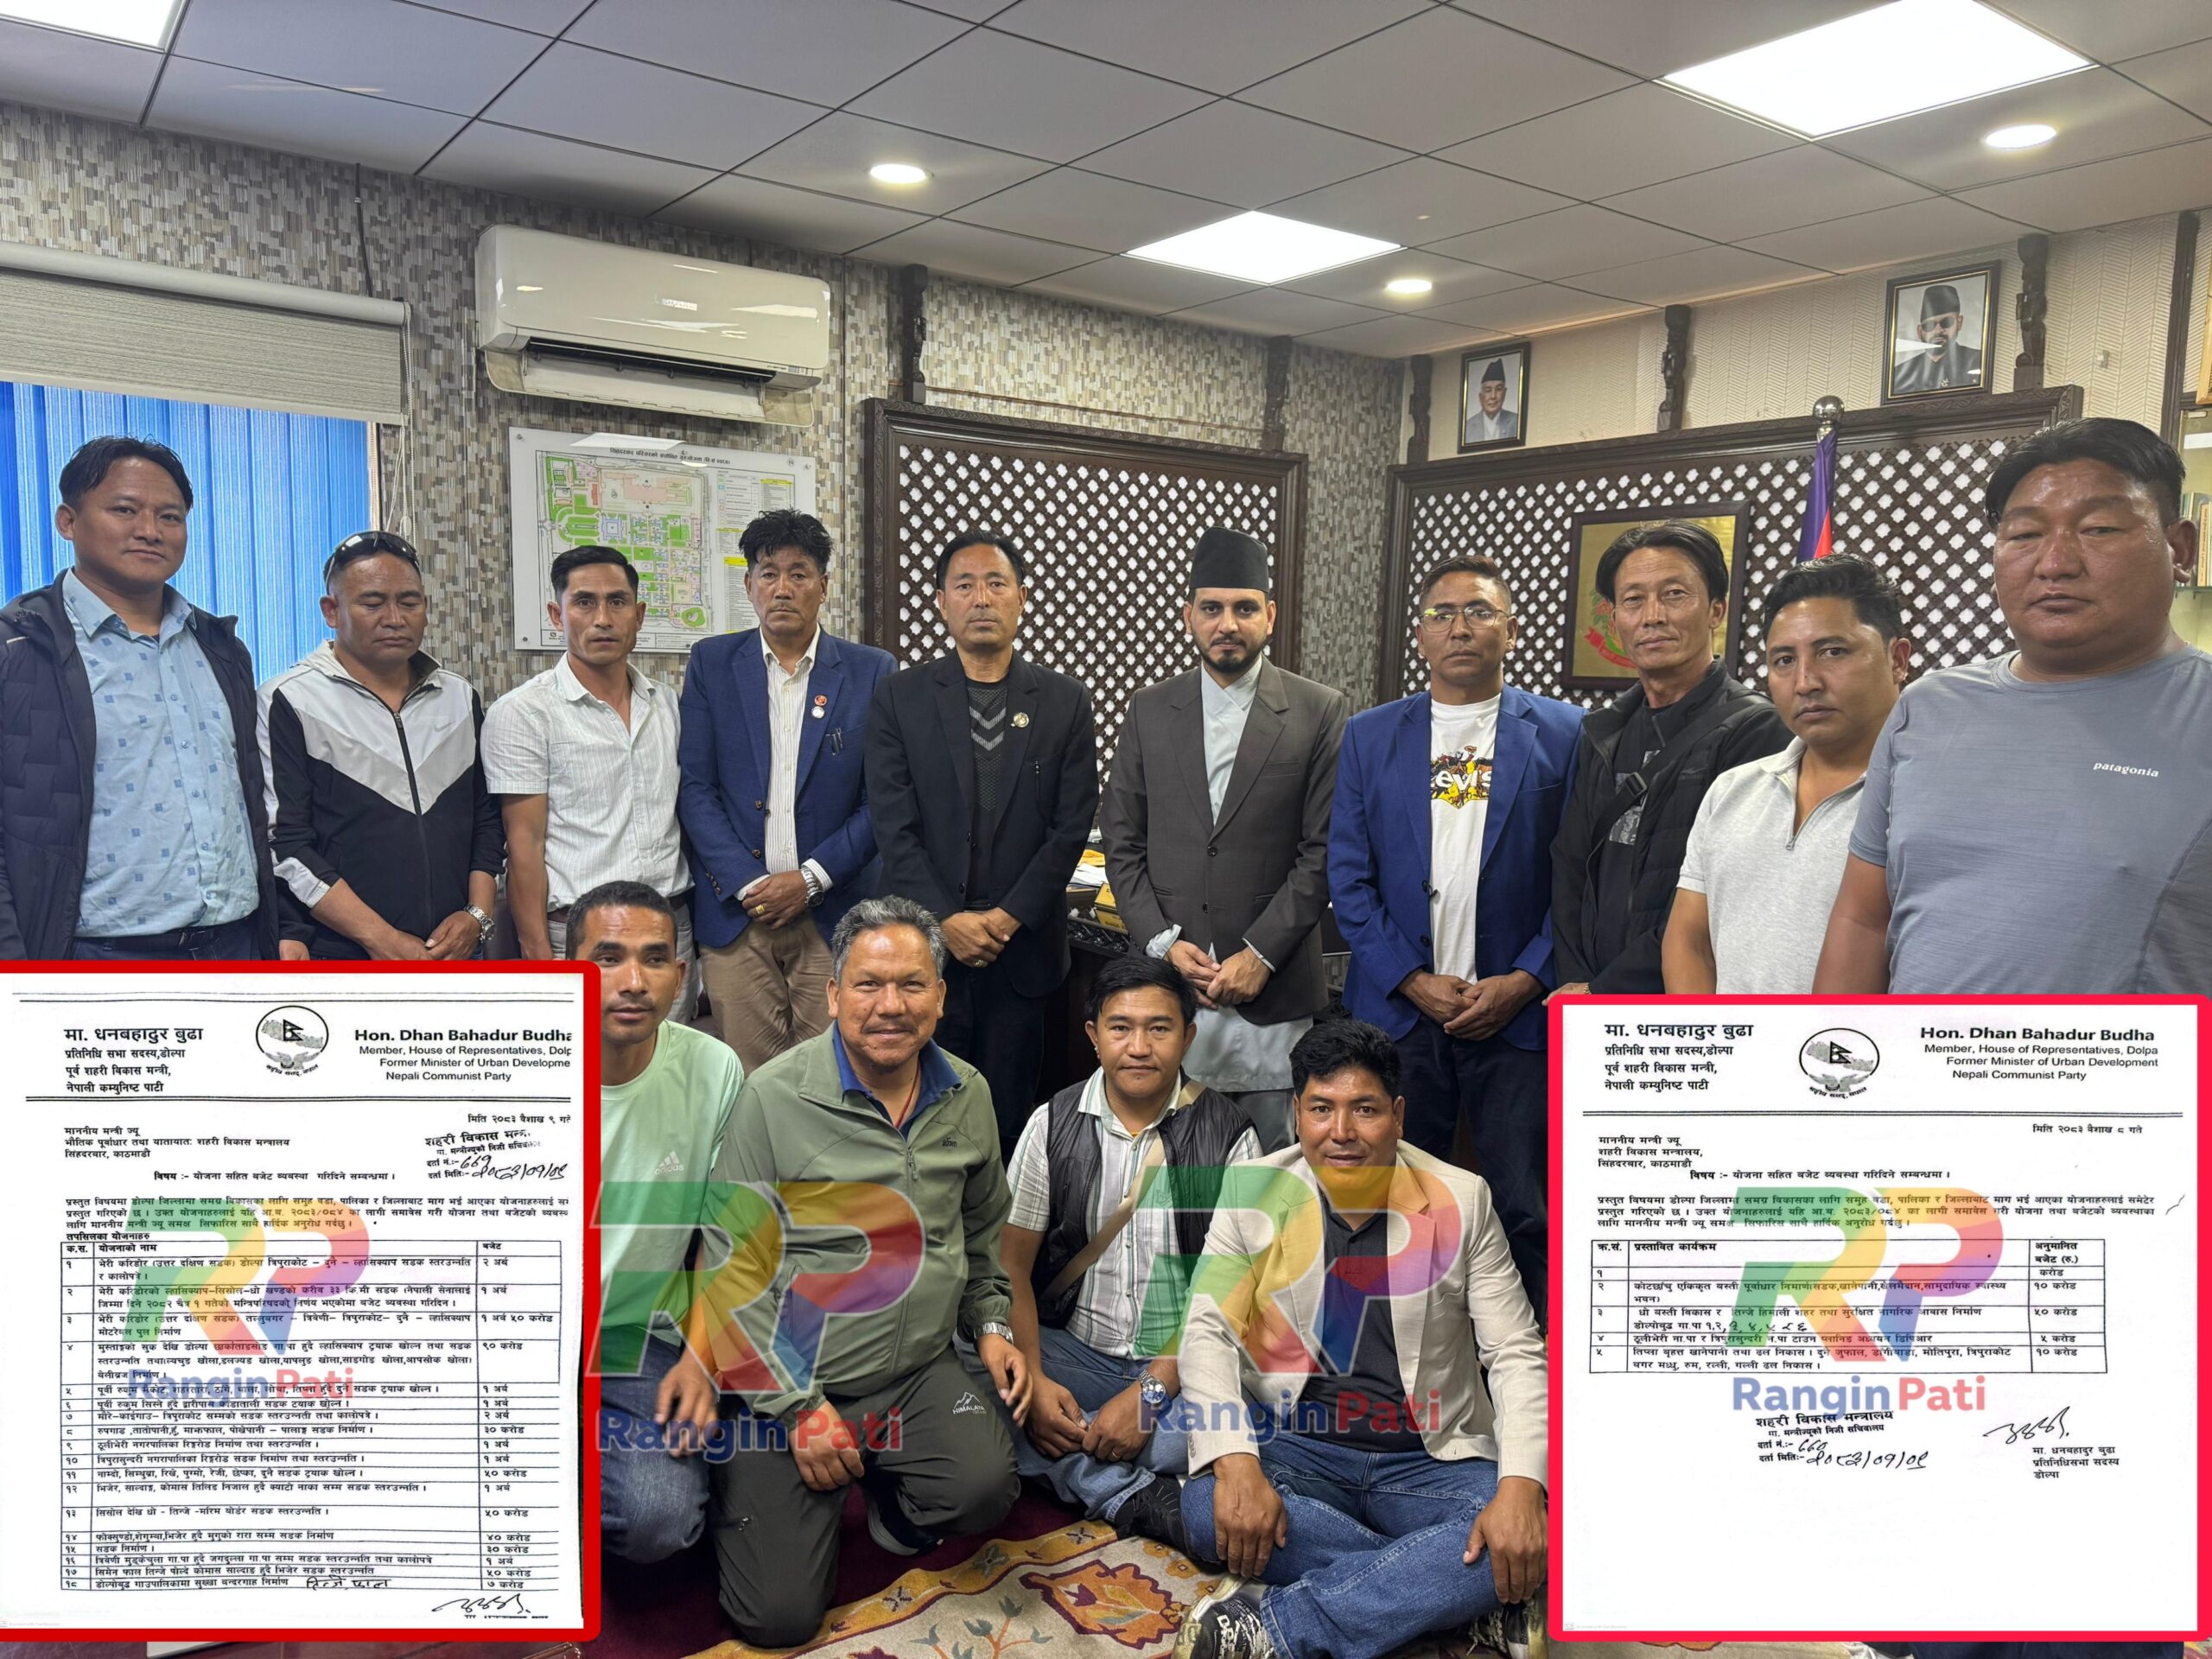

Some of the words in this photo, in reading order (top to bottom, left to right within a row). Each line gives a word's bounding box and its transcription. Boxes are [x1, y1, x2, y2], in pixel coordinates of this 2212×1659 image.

[2093, 762, 2159, 778] patagonia
[1430, 770, 1492, 791] evi's
[63, 1028, 88, 1041] मा.
[94, 1027, 169, 1045] धनबहादुर
[174, 1027, 204, 1044] बुढा
[354, 1029, 395, 1041] Hon.
[399, 1028, 443, 1041] Dhan
[448, 1028, 518, 1041] Bahadur
[1604, 1024, 1630, 1037] मा.
[1637, 1024, 1718, 1041] धनबहादुर
[1721, 1024, 1755, 1040] बुढा
[1920, 1027, 1964, 1039] Hon.
[1969, 1027, 2017, 1039] Dhan
[2022, 1027, 2096, 1040] Bahadur
[2101, 1028, 2155, 1041] Budha
[64, 1046, 103, 1058] प्रतिनिधि
[106, 1049, 127, 1058] सभा
[359, 1046, 406, 1056] Member,
[409, 1046, 443, 1055] House
[445, 1046, 456, 1054] of
[458, 1046, 546, 1057] Representatives,
[1605, 1043, 1645, 1056] प्रतिनिधि
[1648, 1046, 1671, 1056] सभा
[1924, 1044, 1975, 1054] Member,
[1979, 1044, 2015, 1053] House
[2018, 1045, 2030, 1053] of
[2032, 1045, 2123, 1056] Representatives,
[2126, 1046, 2158, 1057] Dolpa
[379, 1058, 418, 1067] Former
[421, 1058, 461, 1067] Minister
[464, 1058, 475, 1067] of
[477, 1058, 509, 1067] Urban
[1946, 1056, 1988, 1065] Former
[1991, 1057, 2035, 1065] Minister
[2037, 1057, 2050, 1066] of
[2051, 1058, 2085, 1066] Urban
[2088, 1058, 2158, 1068] Development
[65, 1064, 80, 1078] पूर्व
[84, 1064, 109, 1077] शहरी
[111, 1064, 143, 1076] विकास
[145, 1063, 171, 1077] मन्त्री,
[1605, 1061, 1620, 1077] पूर्व
[1624, 1061, 1650, 1074] शहरी
[1653, 1061, 1687, 1073] विकास
[1690, 1060, 1718, 1075] मन्त्री,
[385, 1071, 420, 1082] Nepali
[422, 1071, 481, 1080] Communist
[484, 1071, 512, 1083] Party
[1952, 1070, 1988, 1080] Nepali
[1991, 1070, 2055, 1079] Communist
[2058, 1071, 2087, 1082] Party
[66, 1081, 96, 1093] नेपाली
[1604, 1078, 1636, 1090] नेपाली
[467, 1113, 487, 1123] मिति
[492, 1115, 516, 1123] २०८३
[63, 1125, 99, 1135] माननीय
[102, 1125, 124, 1135] मन्त्री
[2032, 1123, 2054, 1133] मिति
[2058, 1125, 2083, 1134] २०८३
[2128, 1125, 2143, 1134] गते
[196, 1136, 219, 1146] शहरी
[223, 1136, 252, 1146] विकास
[1598, 1135, 1636, 1144] माननीय
[1638, 1135, 1662, 1145] मन्त्री
[1598, 1146, 1623, 1156] शहरी
[1626, 1146, 1657, 1156] विकास
[154, 1170, 178, 1180] विषय
[193, 1171, 222, 1180] योजना
[225, 1171, 249, 1180] सहित
[316, 1171, 346, 1180] गरिदिने
[1689, 1169, 1716, 1180] विषय
[1732, 1169, 1764, 1179] योजना
[1767, 1169, 1793, 1179] सहित
[1863, 1169, 1896, 1179] गरिदिने
[98, 1242, 137, 1253] योजनाको
[2035, 1240, 2079, 1252] अनुमानित
[2039, 1267, 2064, 1277] करोड
[2034, 1281, 2048, 1290] १०
[2052, 1280, 2077, 1290] करोड
[2053, 1306, 2078, 1316] करोड
[499, 1340, 523, 1351] करोड
[1756, 1414, 1789, 1428] शहरी
[2093, 1458, 2120, 1466] सदस्य
